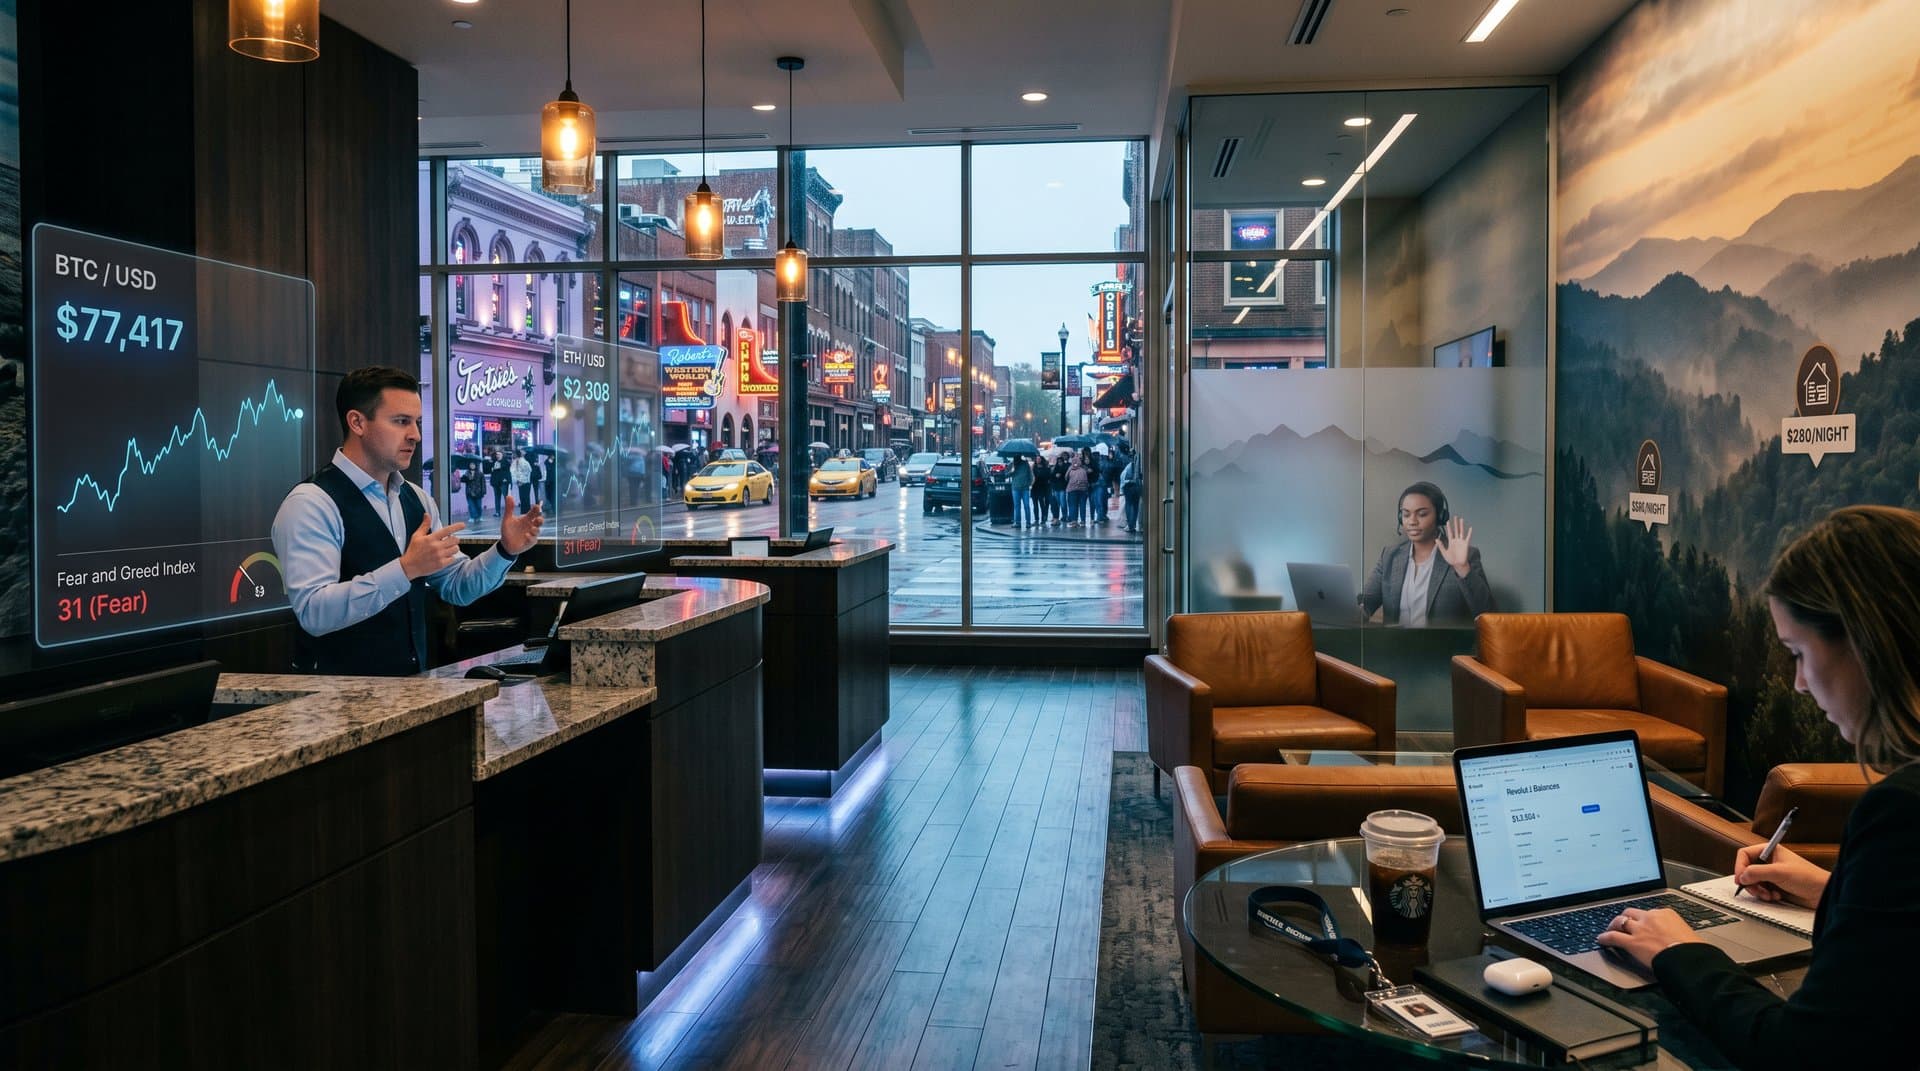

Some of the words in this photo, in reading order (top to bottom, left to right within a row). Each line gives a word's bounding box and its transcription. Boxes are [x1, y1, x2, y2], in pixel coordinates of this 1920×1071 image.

[56, 253, 98, 281] BTC
[103, 263, 111, 287] /
[115, 264, 156, 291] USD
[56, 301, 184, 353] $77,417
[563, 350, 582, 365] ETH
[587, 353, 605, 368] USD
[456, 358, 519, 405] Tootsie's
[563, 376, 610, 405] $2,308
[1786, 426, 1849, 445] $280/NIGHT
[563, 525, 577, 535] Fear
[563, 540, 575, 556] 31
[576, 536, 602, 555] (Fear)
[57, 571, 88, 587] Fear
[92, 567, 116, 583] and
[120, 563, 160, 581] Greed
[163, 560, 196, 576] Index
[57, 597, 83, 622] 31
[90, 589, 148, 621] (Fear)
[1506, 786, 1529, 796] Revolut
[1533, 783, 1560, 793] Balances
